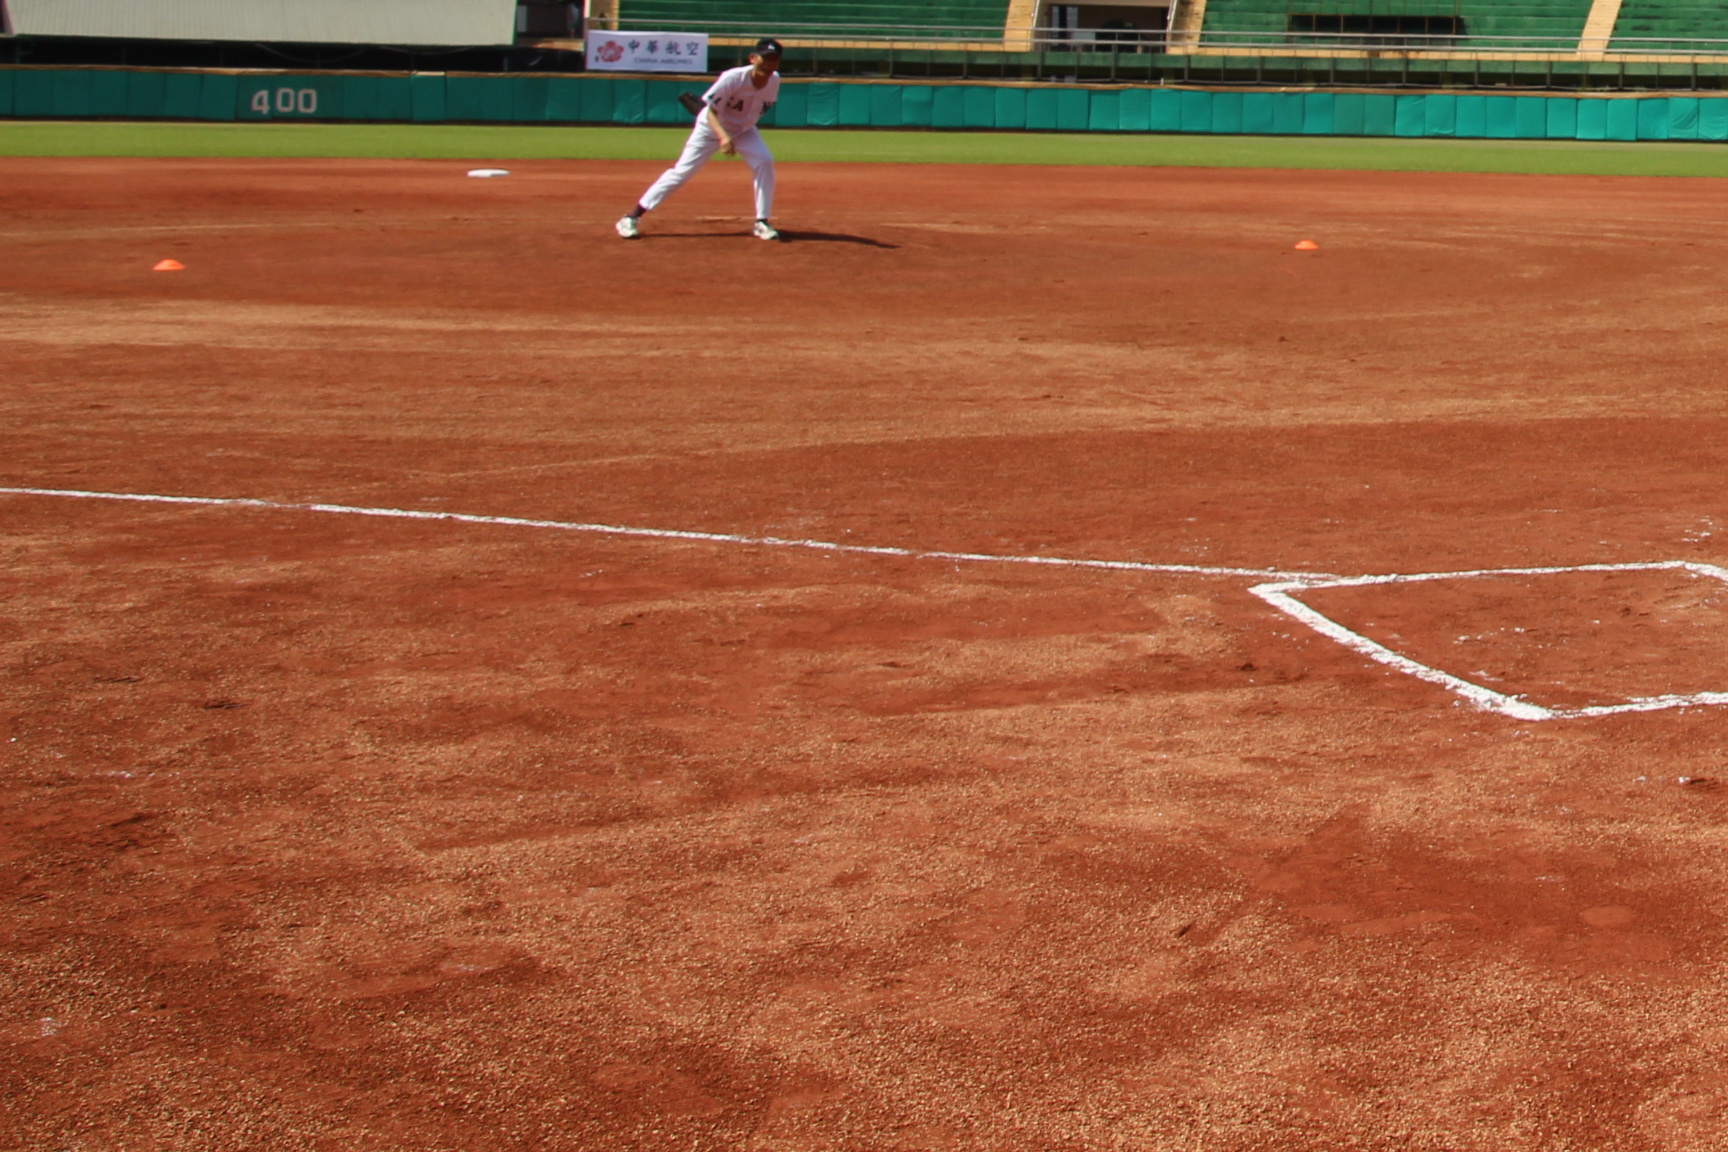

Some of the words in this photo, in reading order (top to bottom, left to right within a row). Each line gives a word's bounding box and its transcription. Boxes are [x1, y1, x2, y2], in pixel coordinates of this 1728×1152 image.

[628, 38, 700, 56] 中華航空
[251, 87, 317, 114] 400
